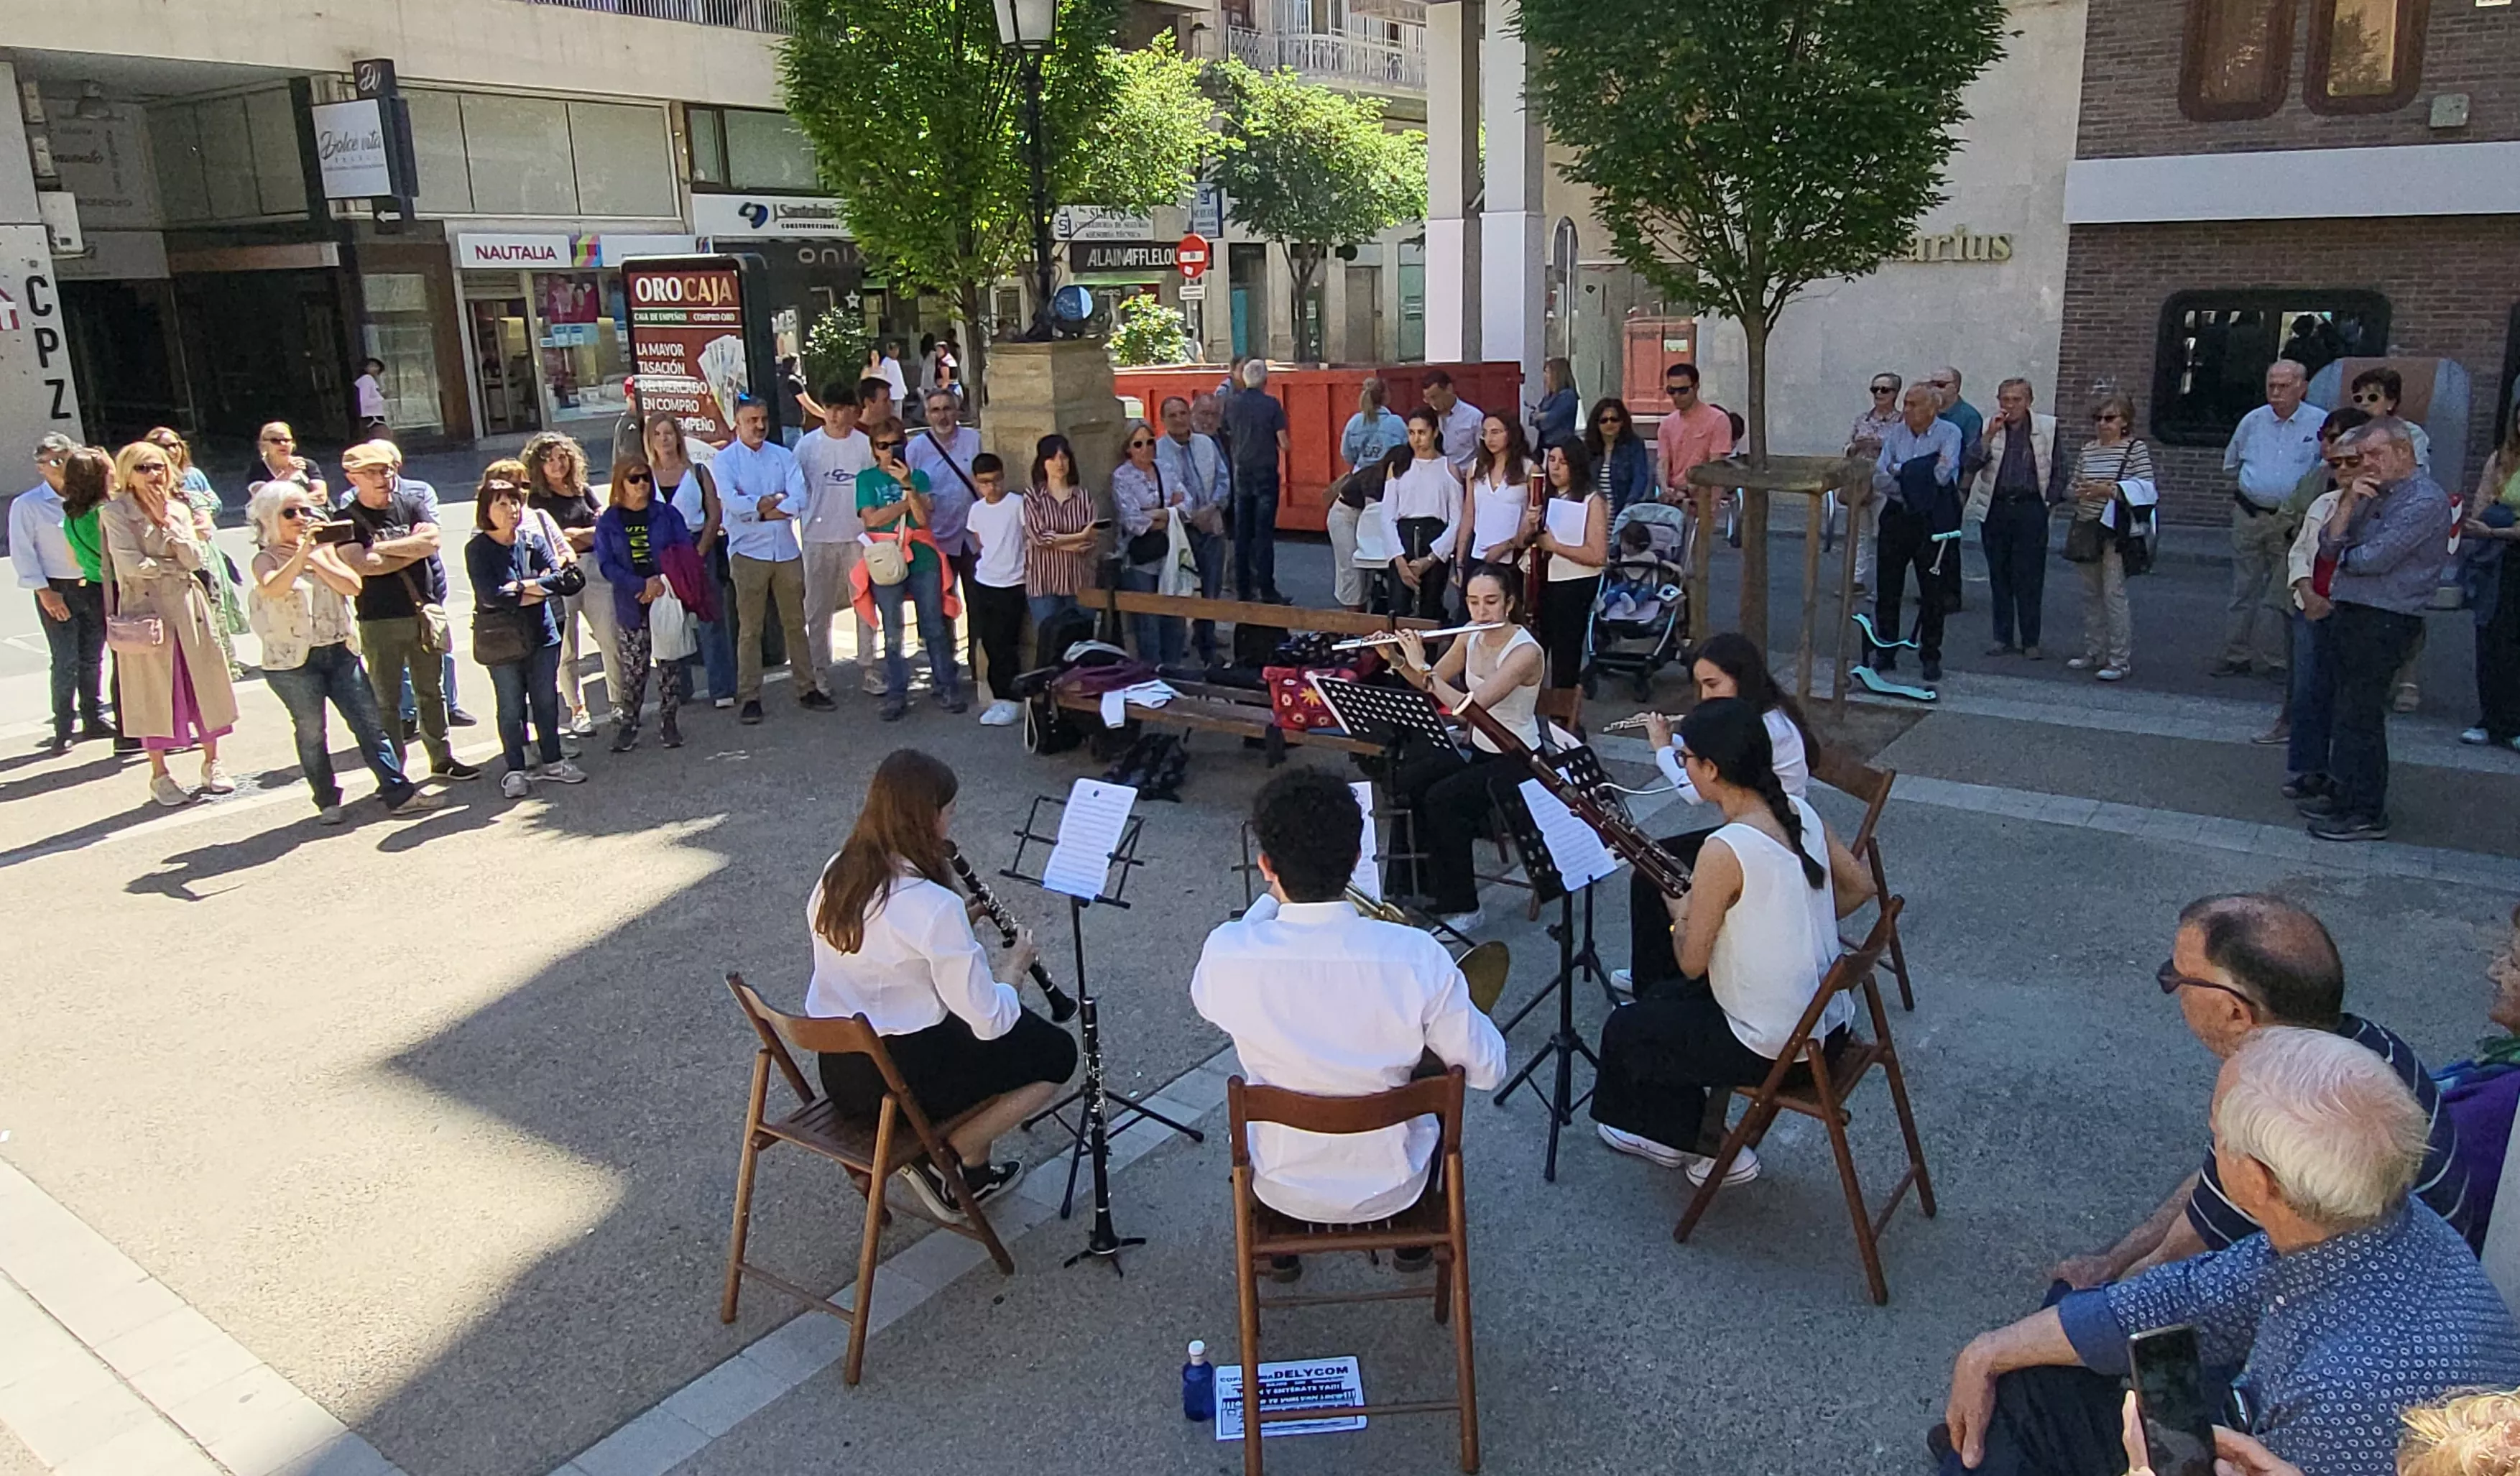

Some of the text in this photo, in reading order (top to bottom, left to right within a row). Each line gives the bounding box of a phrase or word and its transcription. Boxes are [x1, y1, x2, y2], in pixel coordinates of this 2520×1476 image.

[474, 245, 558, 261] NAUTALIA
[650, 313, 658, 321] DE
[636, 342, 685, 357] LA MAYOR
[637, 360, 686, 375] TASACIÓN
[642, 397, 699, 413] EN COMPRO
[1274, 1366, 1349, 1379] DELYCOM
